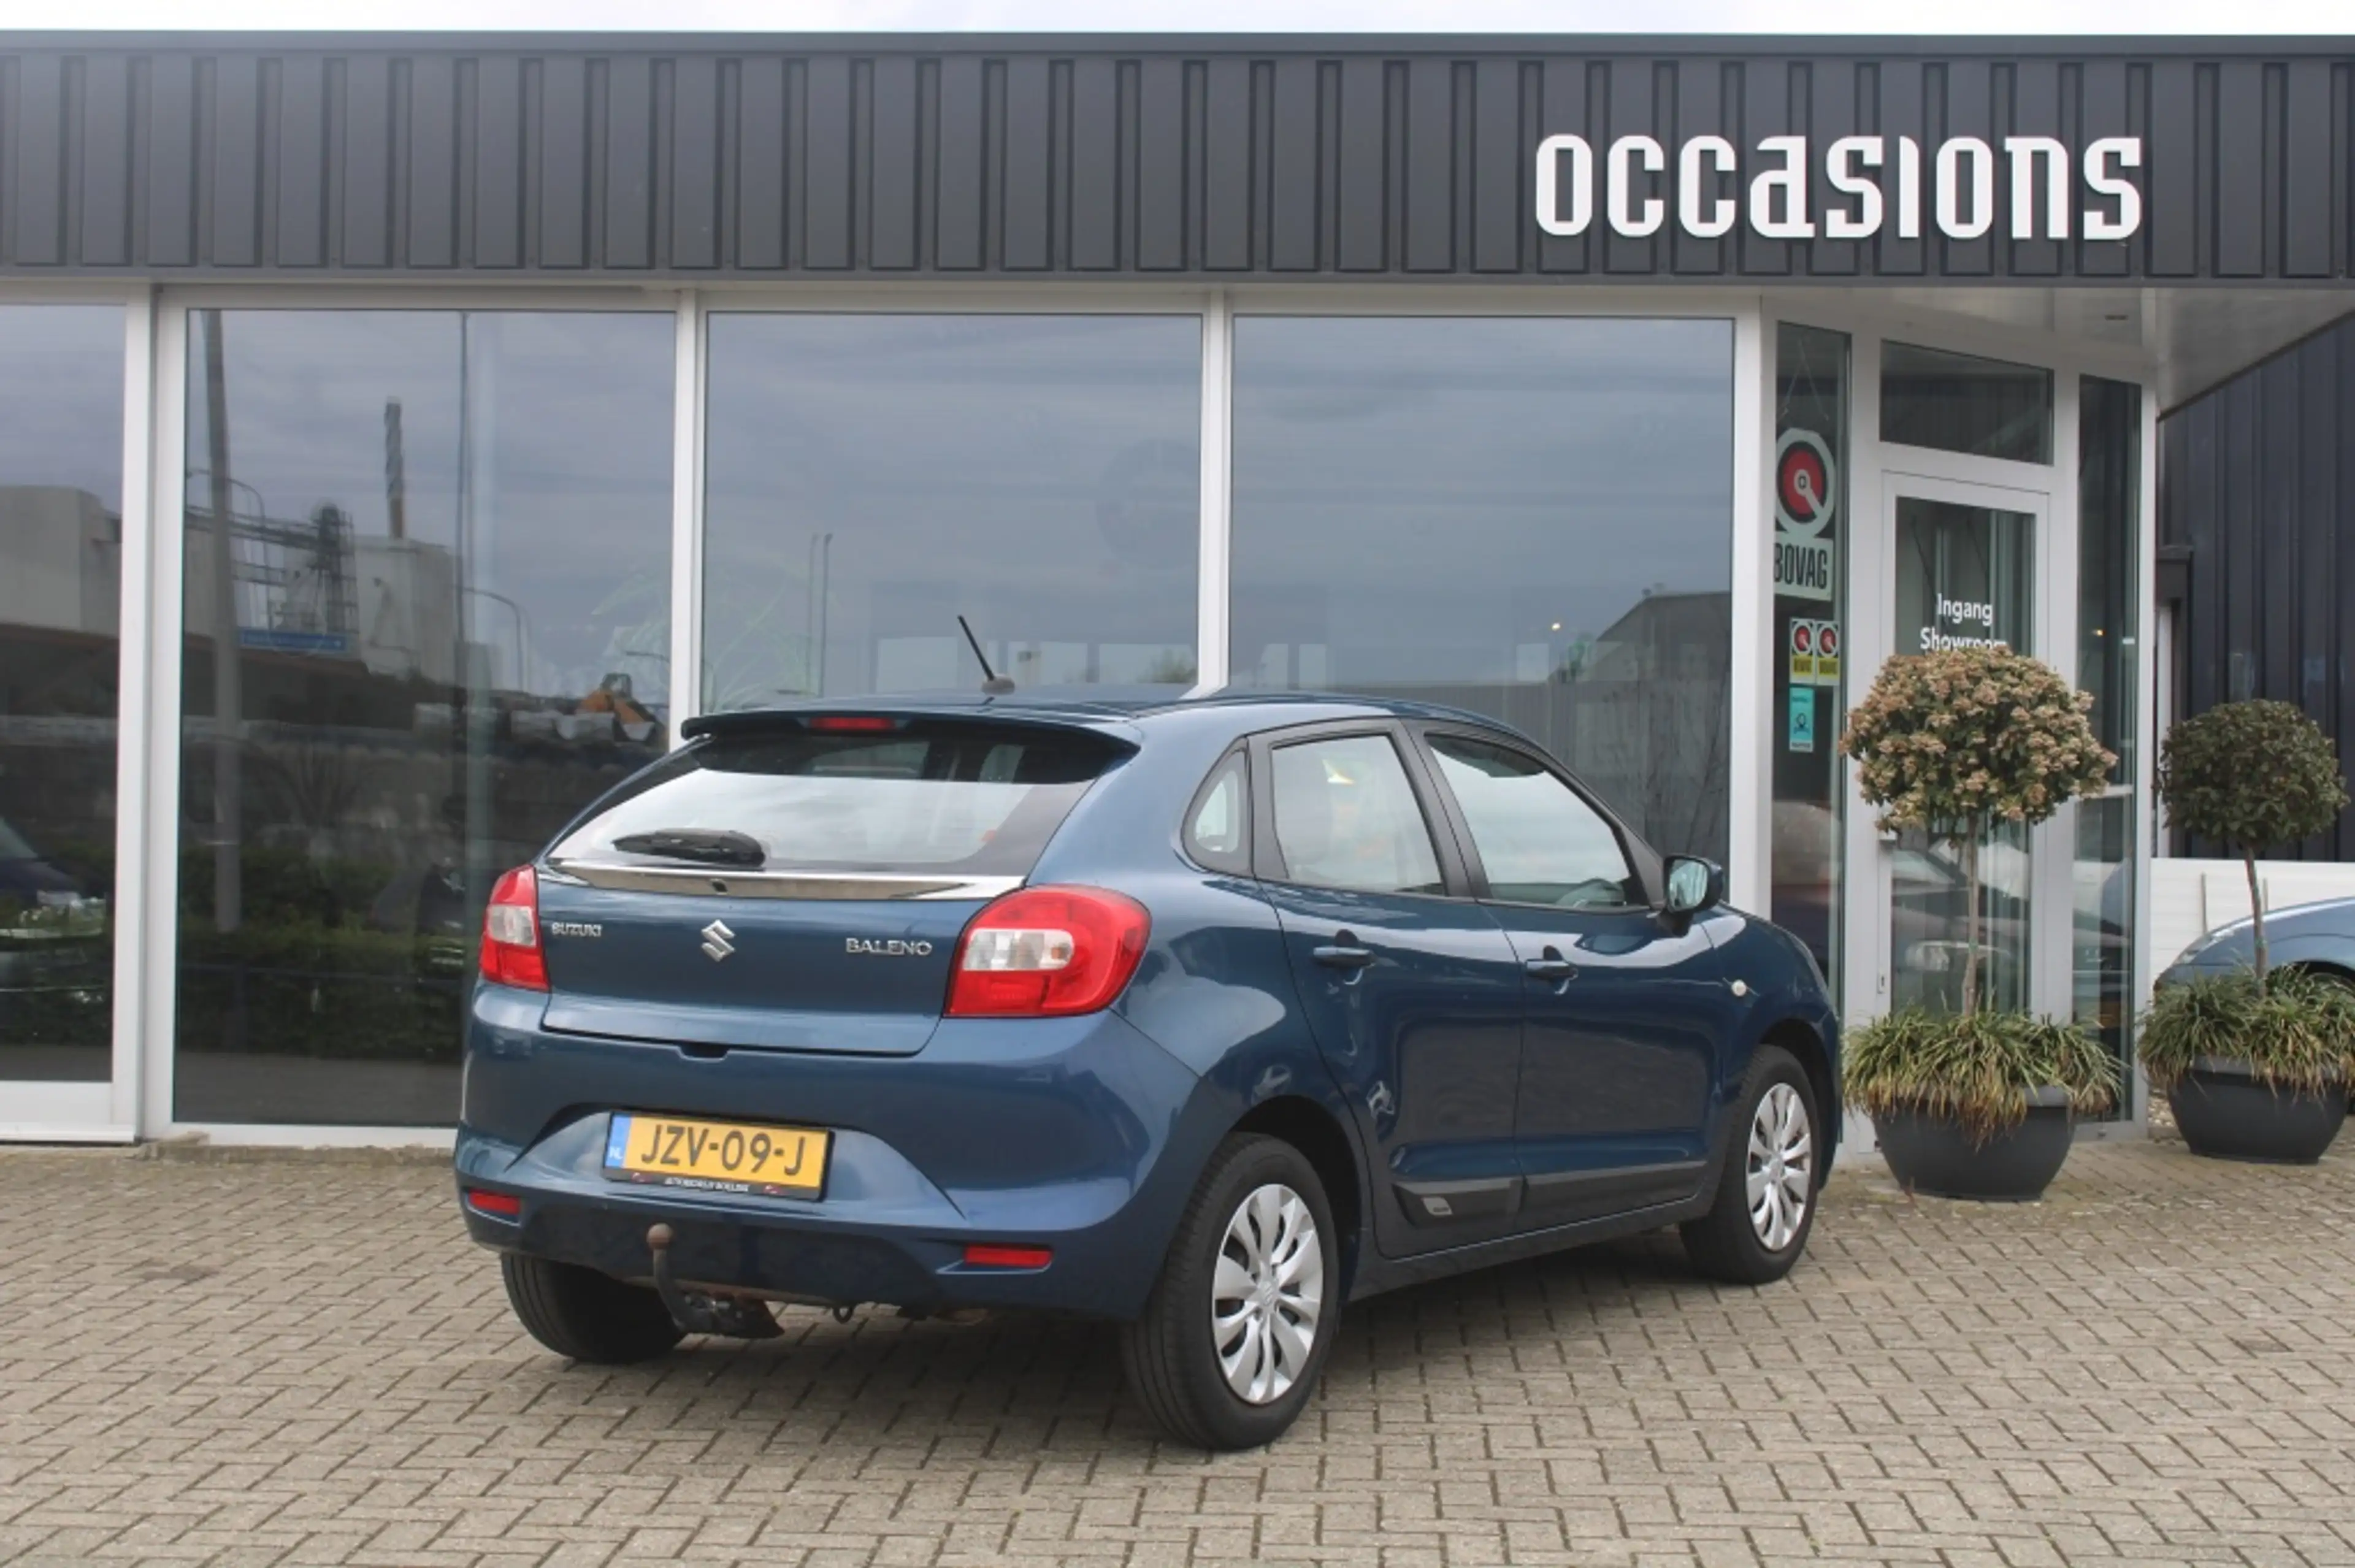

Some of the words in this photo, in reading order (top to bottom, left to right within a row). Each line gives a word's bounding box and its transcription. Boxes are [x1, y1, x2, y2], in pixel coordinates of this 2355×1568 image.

[1774, 542, 1828, 589] BOVAG
[1937, 592, 1993, 626] Ingang
[551, 922, 602, 937] SUZUKI
[846, 938, 933, 956] BALENO
[609, 1146, 624, 1160] NL
[641, 1124, 806, 1177] JZV-09-J
